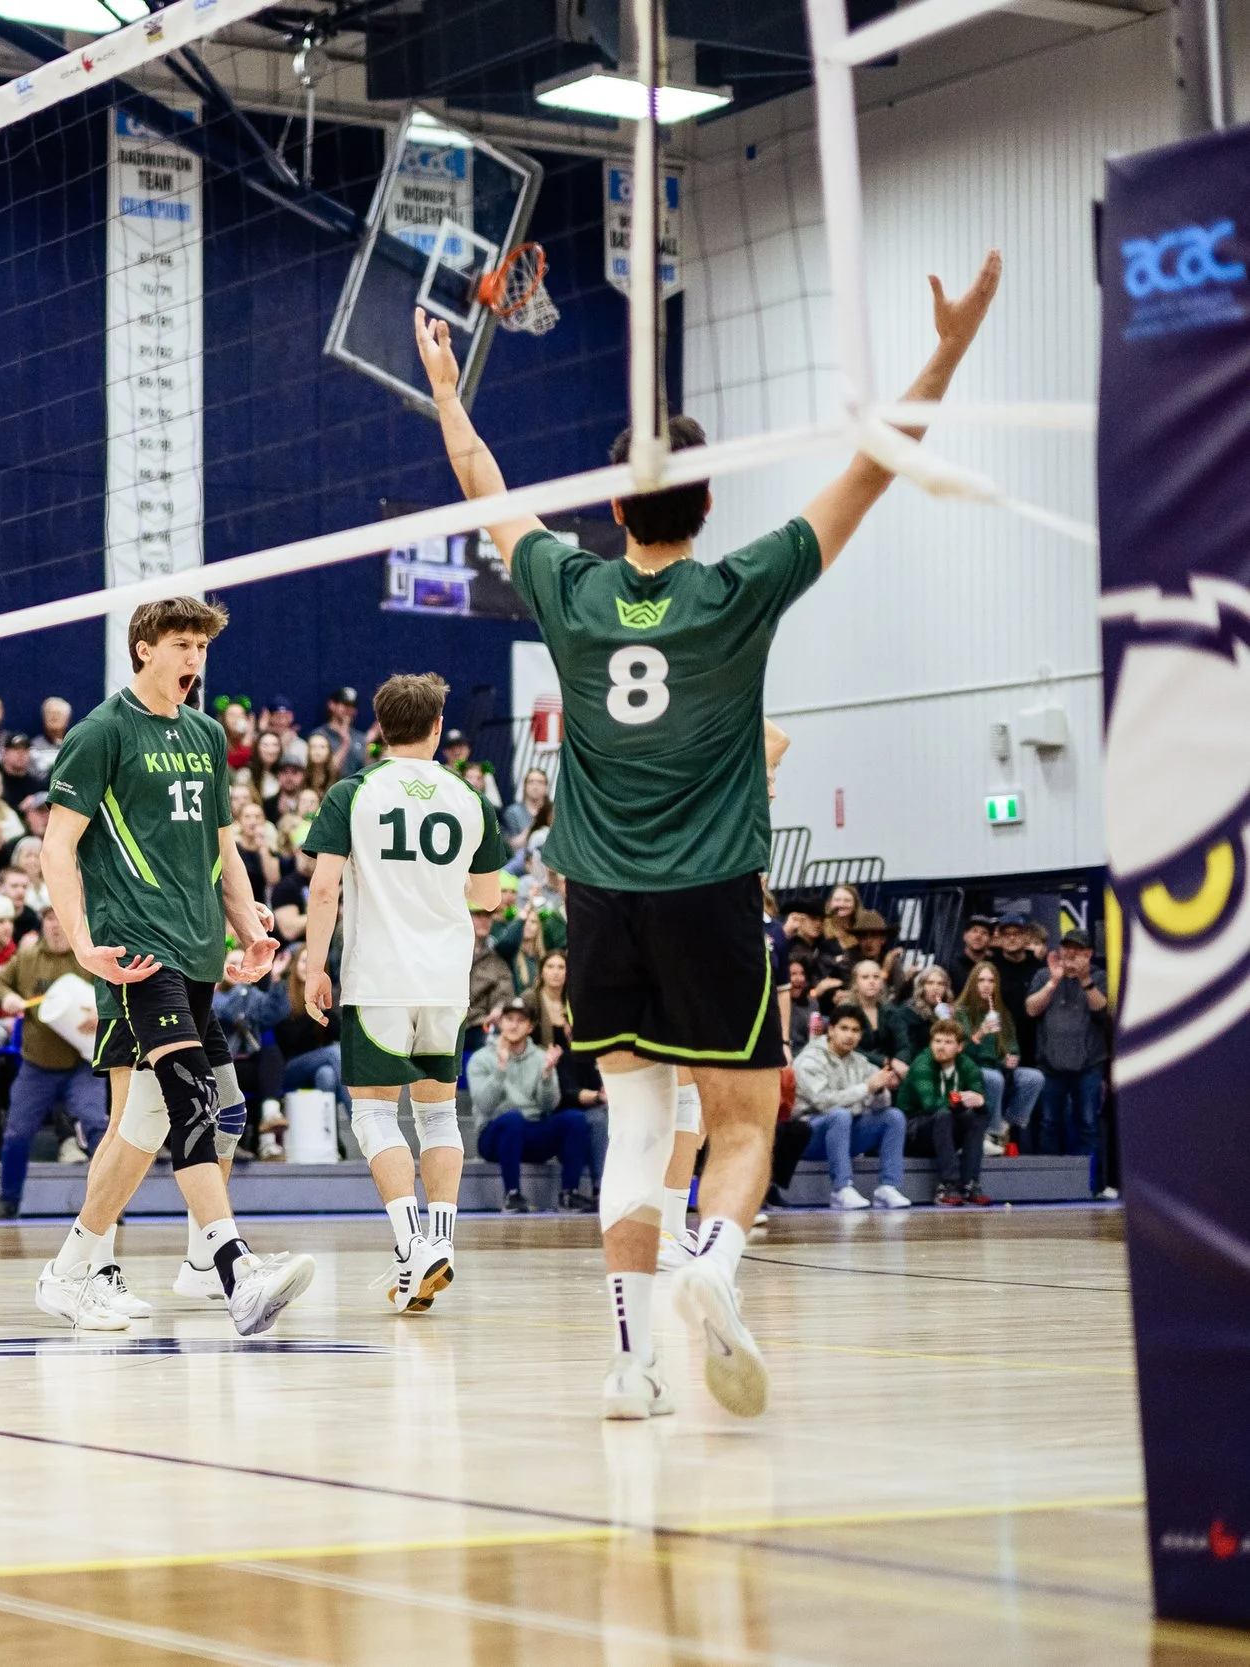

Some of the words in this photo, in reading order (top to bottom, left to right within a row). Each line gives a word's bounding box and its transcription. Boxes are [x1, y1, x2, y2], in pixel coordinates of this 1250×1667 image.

[1120, 219, 1247, 299] acac
[606, 645, 670, 725] 8
[144, 752, 214, 774] KINGS
[168, 780, 204, 821] 13
[379, 807, 463, 866] 10
